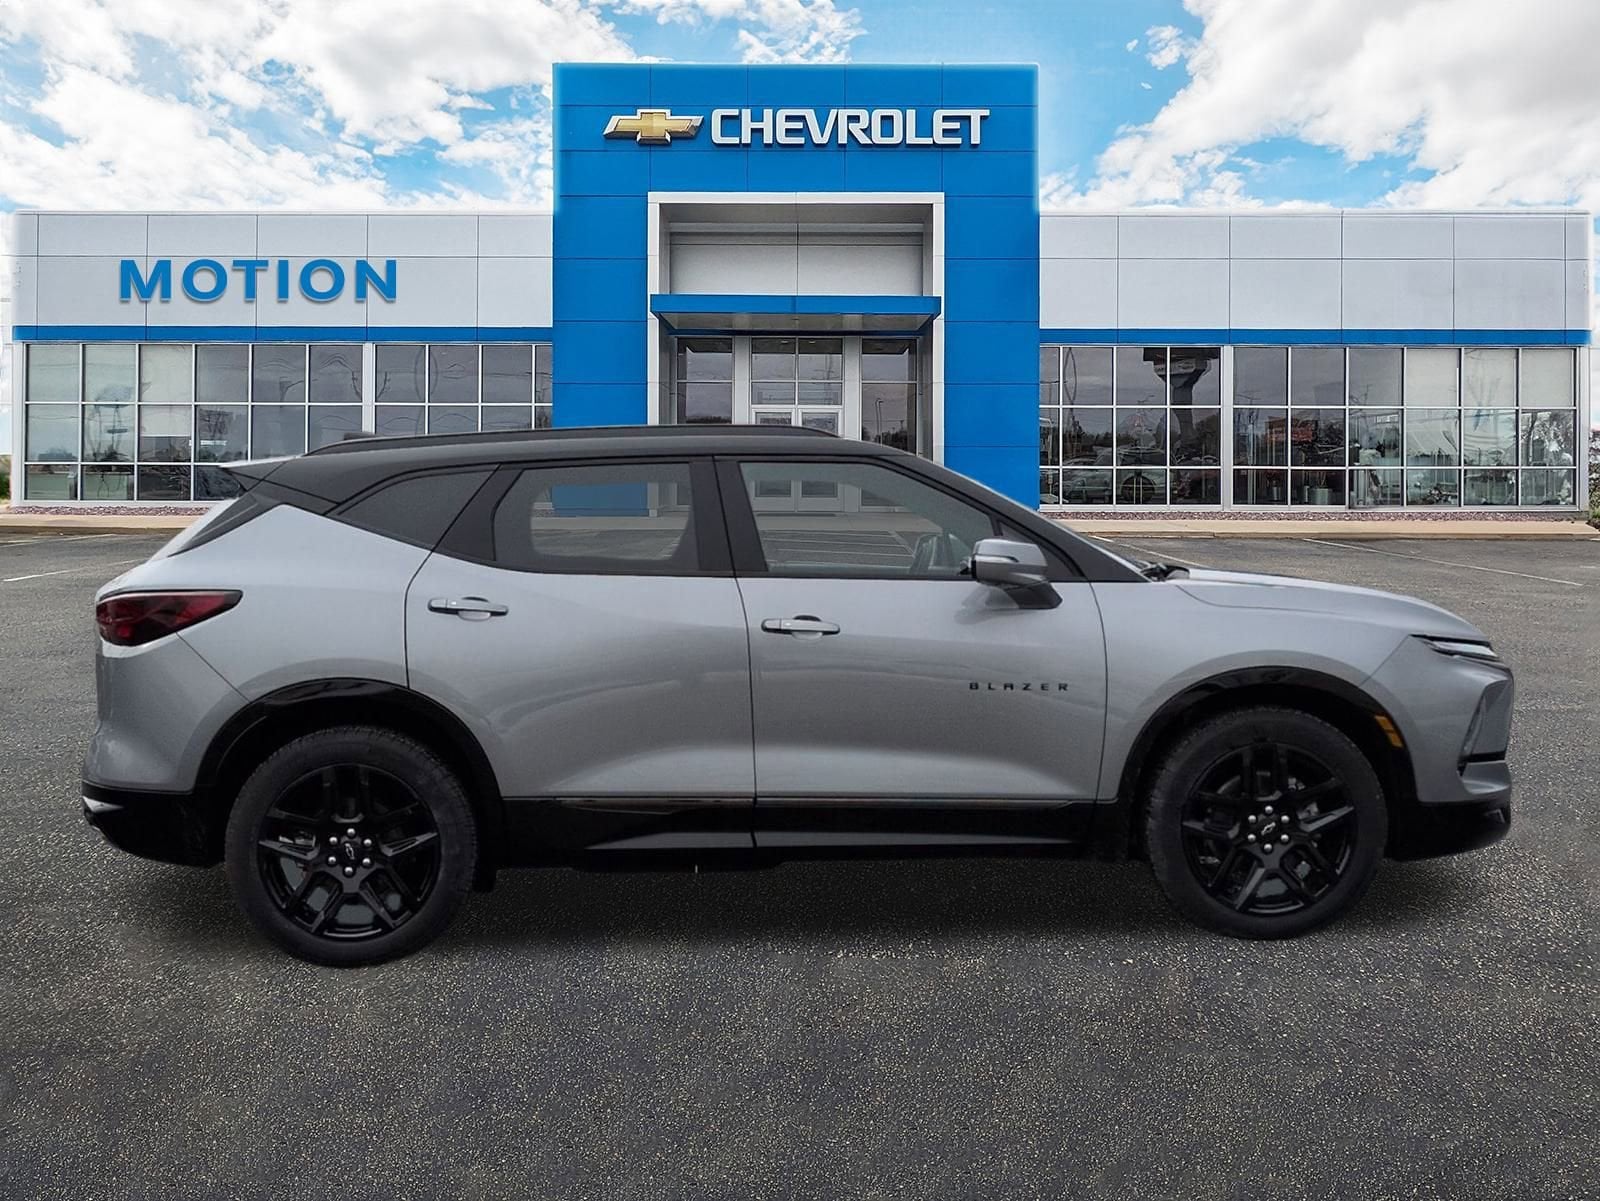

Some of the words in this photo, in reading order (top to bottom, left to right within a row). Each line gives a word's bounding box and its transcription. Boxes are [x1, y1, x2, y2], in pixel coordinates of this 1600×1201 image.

[711, 108, 991, 145] CHEVROLET
[119, 259, 397, 302] MOTION
[968, 682, 1069, 691] BLAZER
